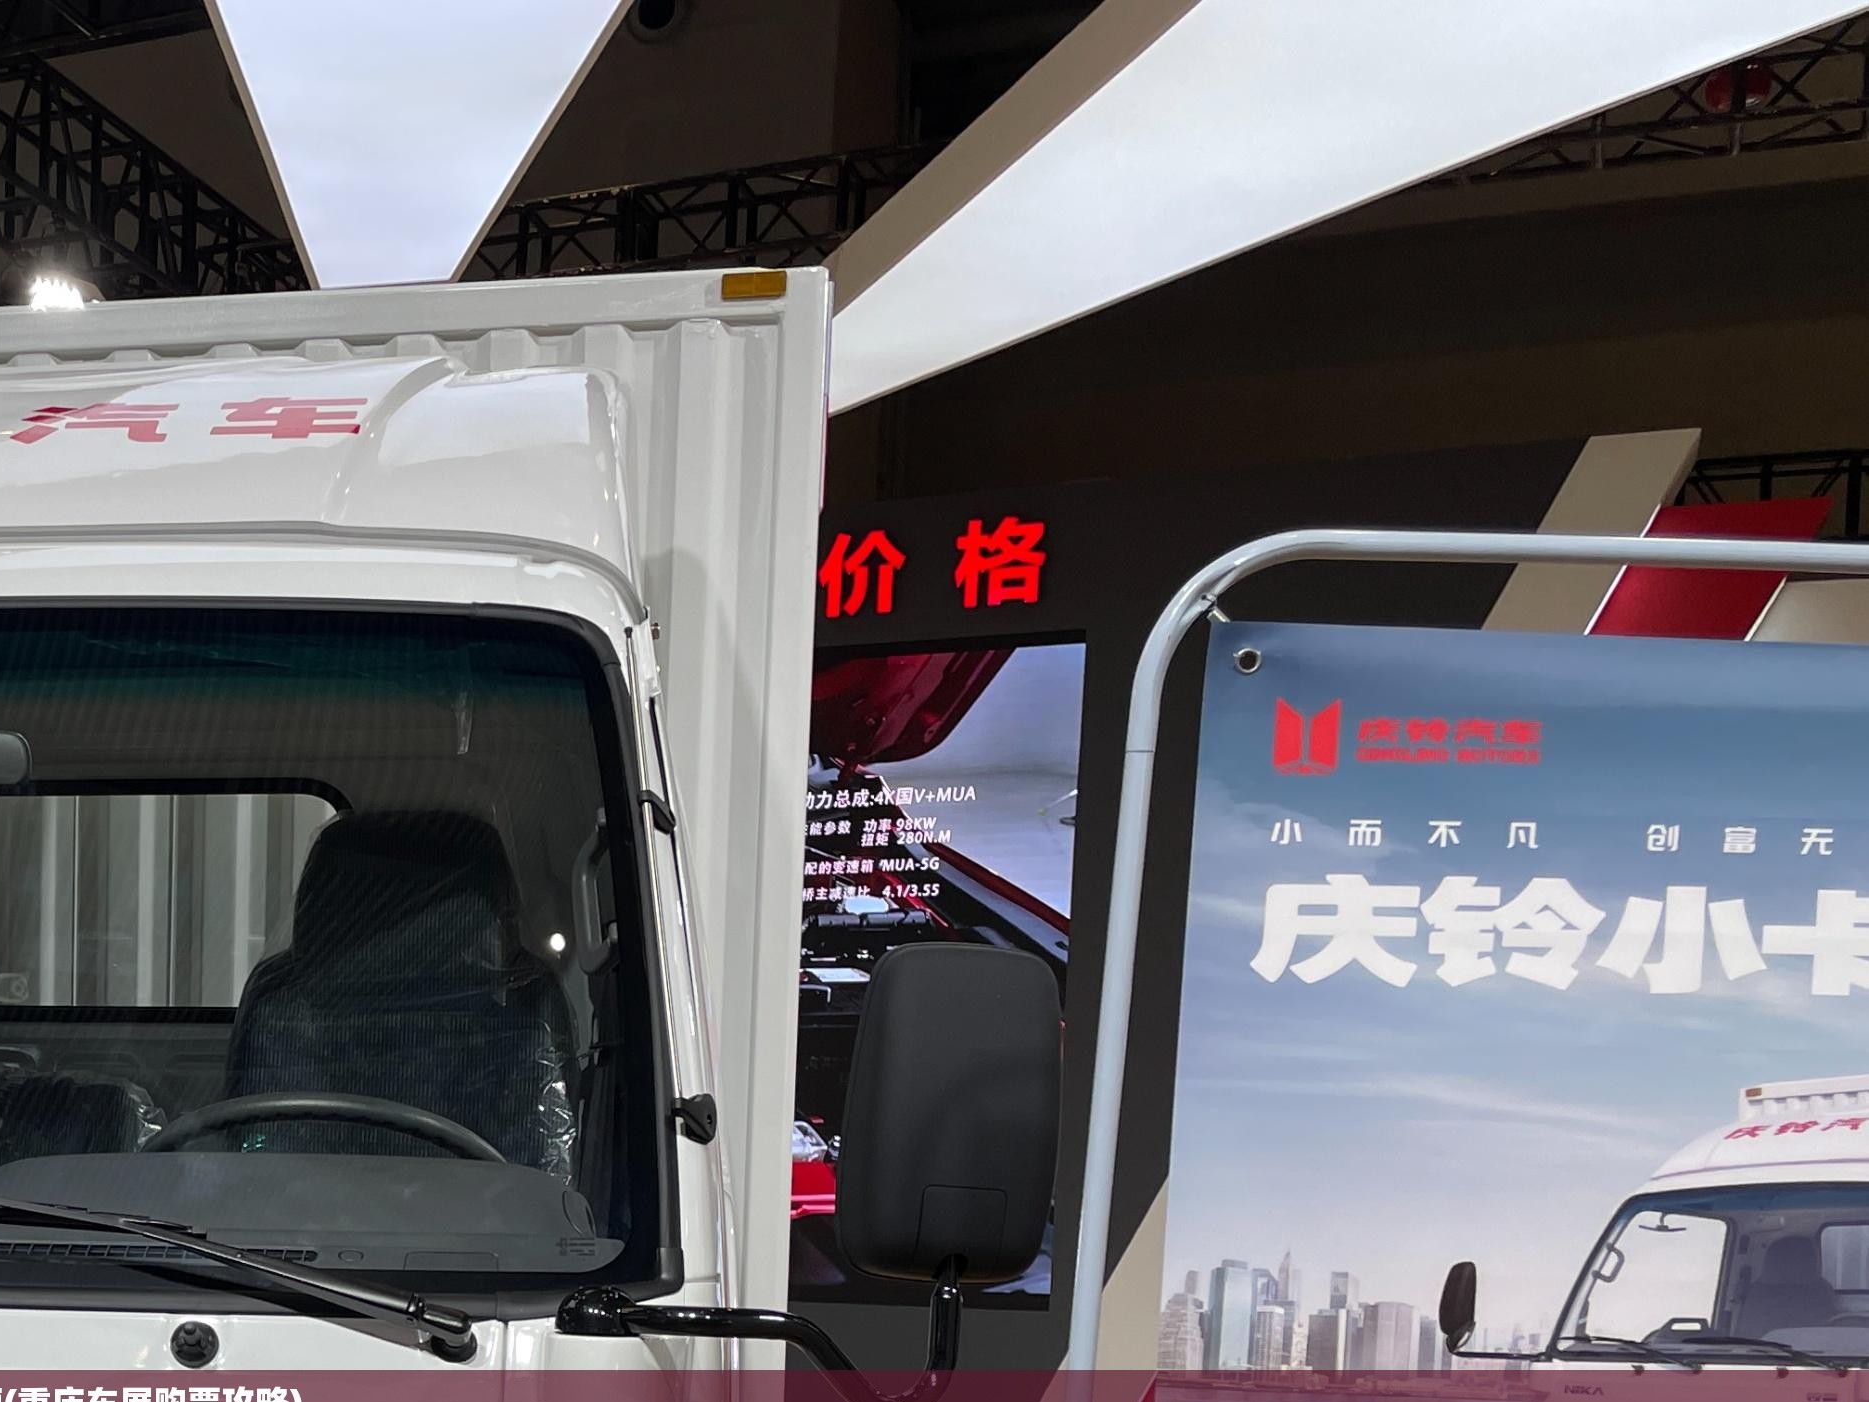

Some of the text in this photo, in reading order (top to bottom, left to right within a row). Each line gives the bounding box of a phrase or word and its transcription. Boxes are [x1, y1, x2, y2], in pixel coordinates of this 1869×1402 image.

[819, 516, 1047, 618] 价格
[1357, 717, 1542, 745] 庆铃汽车
[804, 817, 937, 836] 能参数 功率 98KW
[1270, 818, 1834, 856] 小而不凡 创富无
[861, 830, 951, 847] 扭矩 280N.M
[882, 884, 940, 898] 4.1/3.55
[1250, 873, 1869, 997] 庆铃小卡
[1564, 1384, 1604, 1396] NIKA
